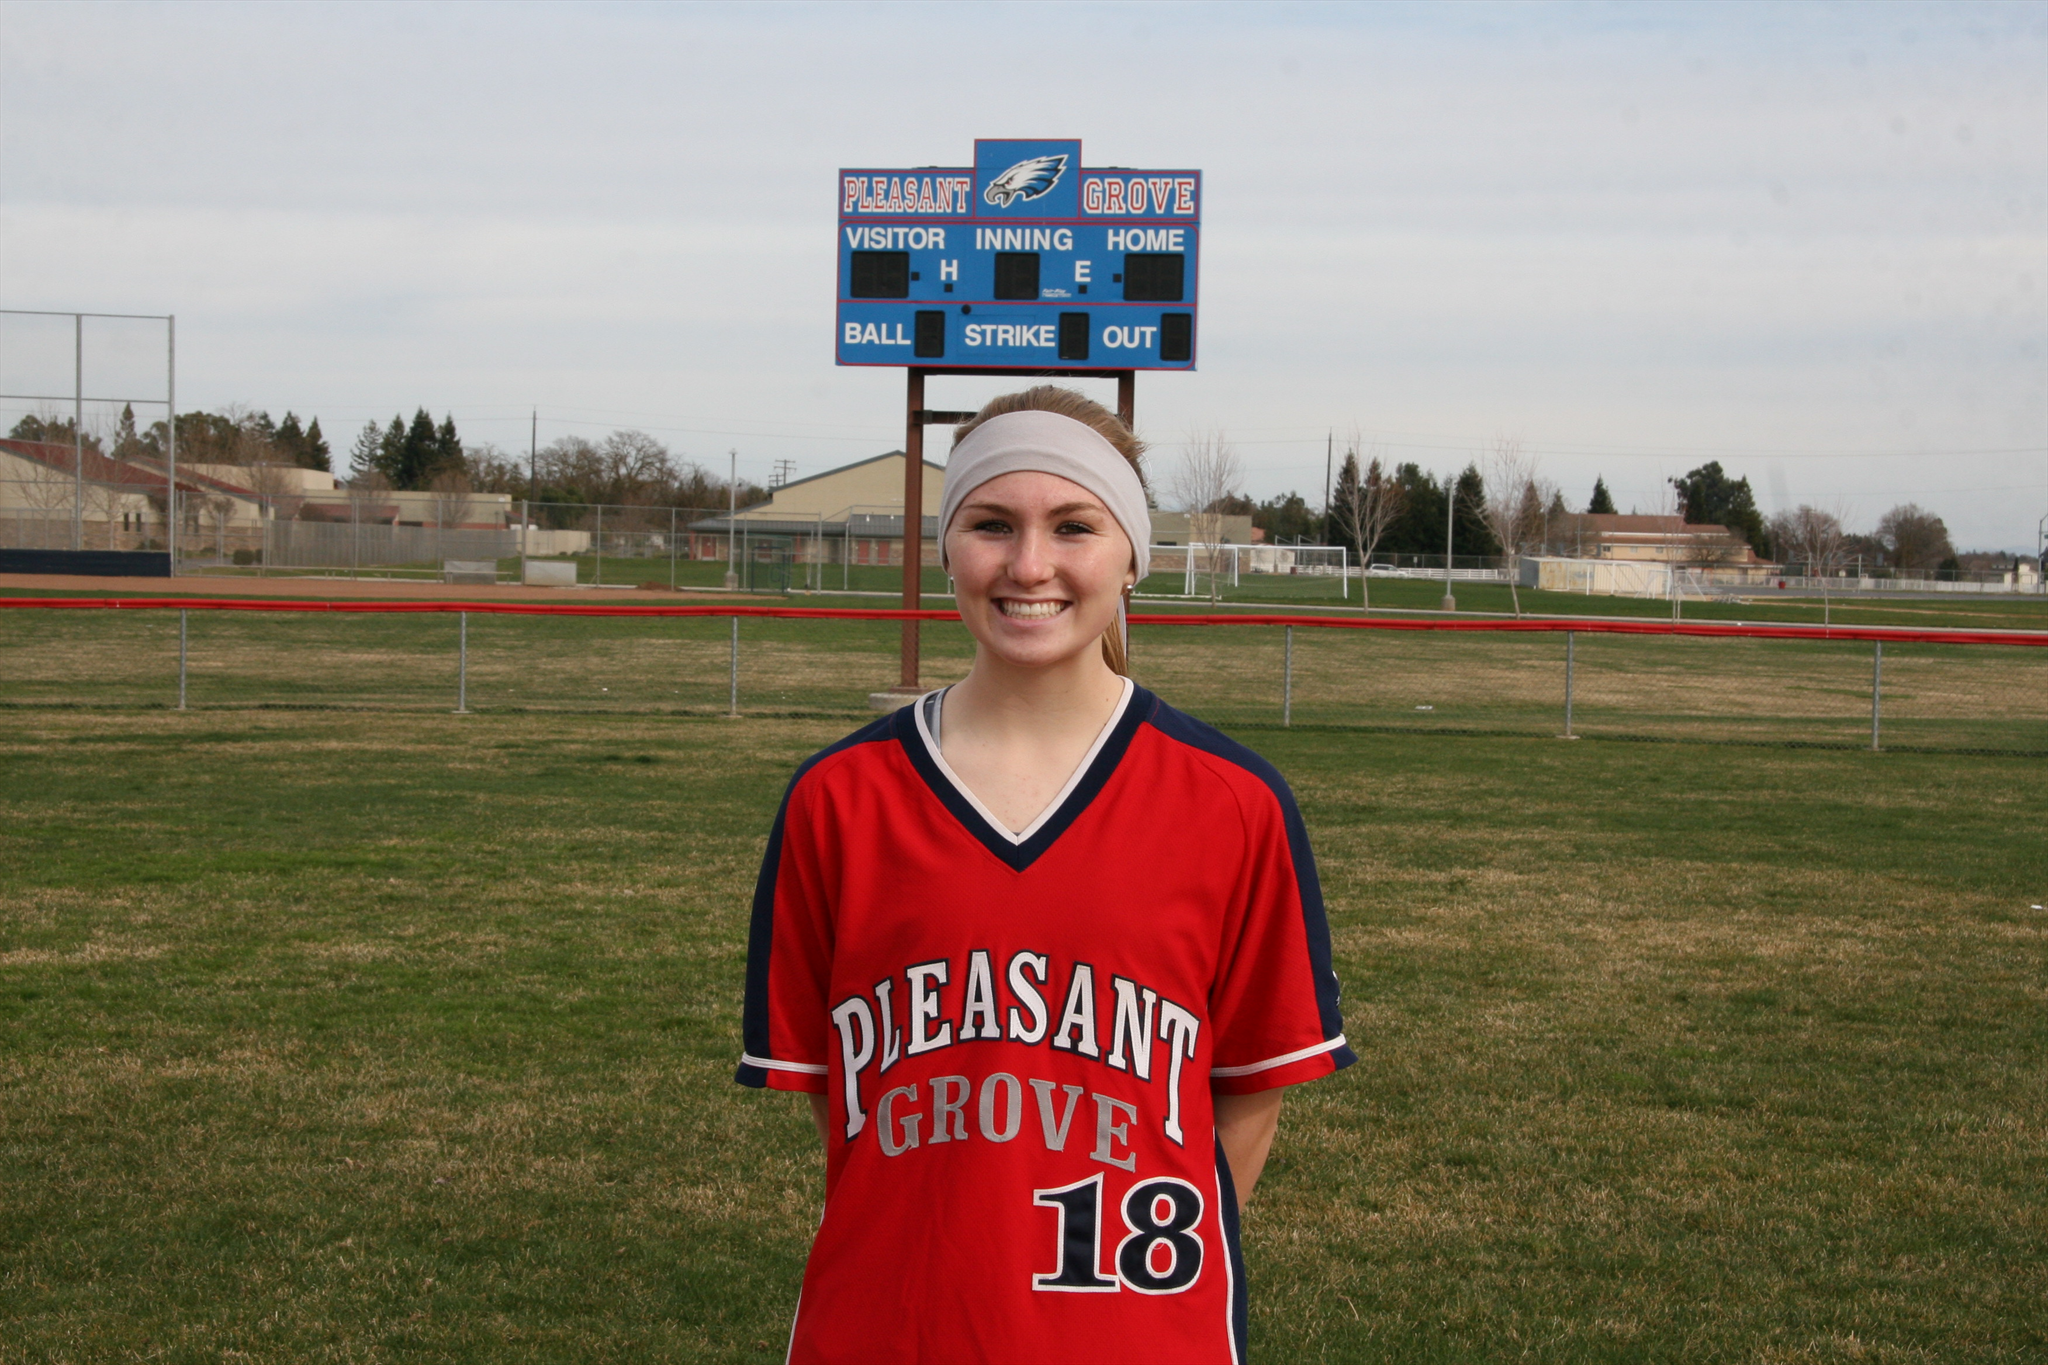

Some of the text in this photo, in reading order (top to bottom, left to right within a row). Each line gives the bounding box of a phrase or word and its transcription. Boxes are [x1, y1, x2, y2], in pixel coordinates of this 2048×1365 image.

[844, 177, 1195, 214] PLEASANT GROVE
[846, 227, 946, 250] VISITOR
[975, 228, 1073, 250] INNING
[1107, 228, 1185, 251] HOME
[940, 259, 958, 281] H
[1075, 260, 1091, 282] E
[844, 322, 911, 345] BALL
[964, 324, 1056, 347] STRIKE
[1102, 325, 1157, 348] OUT
[831, 948, 1201, 1148] PLEASANT
[877, 1072, 1138, 1174] GROVE
[1032, 1171, 1205, 1296] 18
